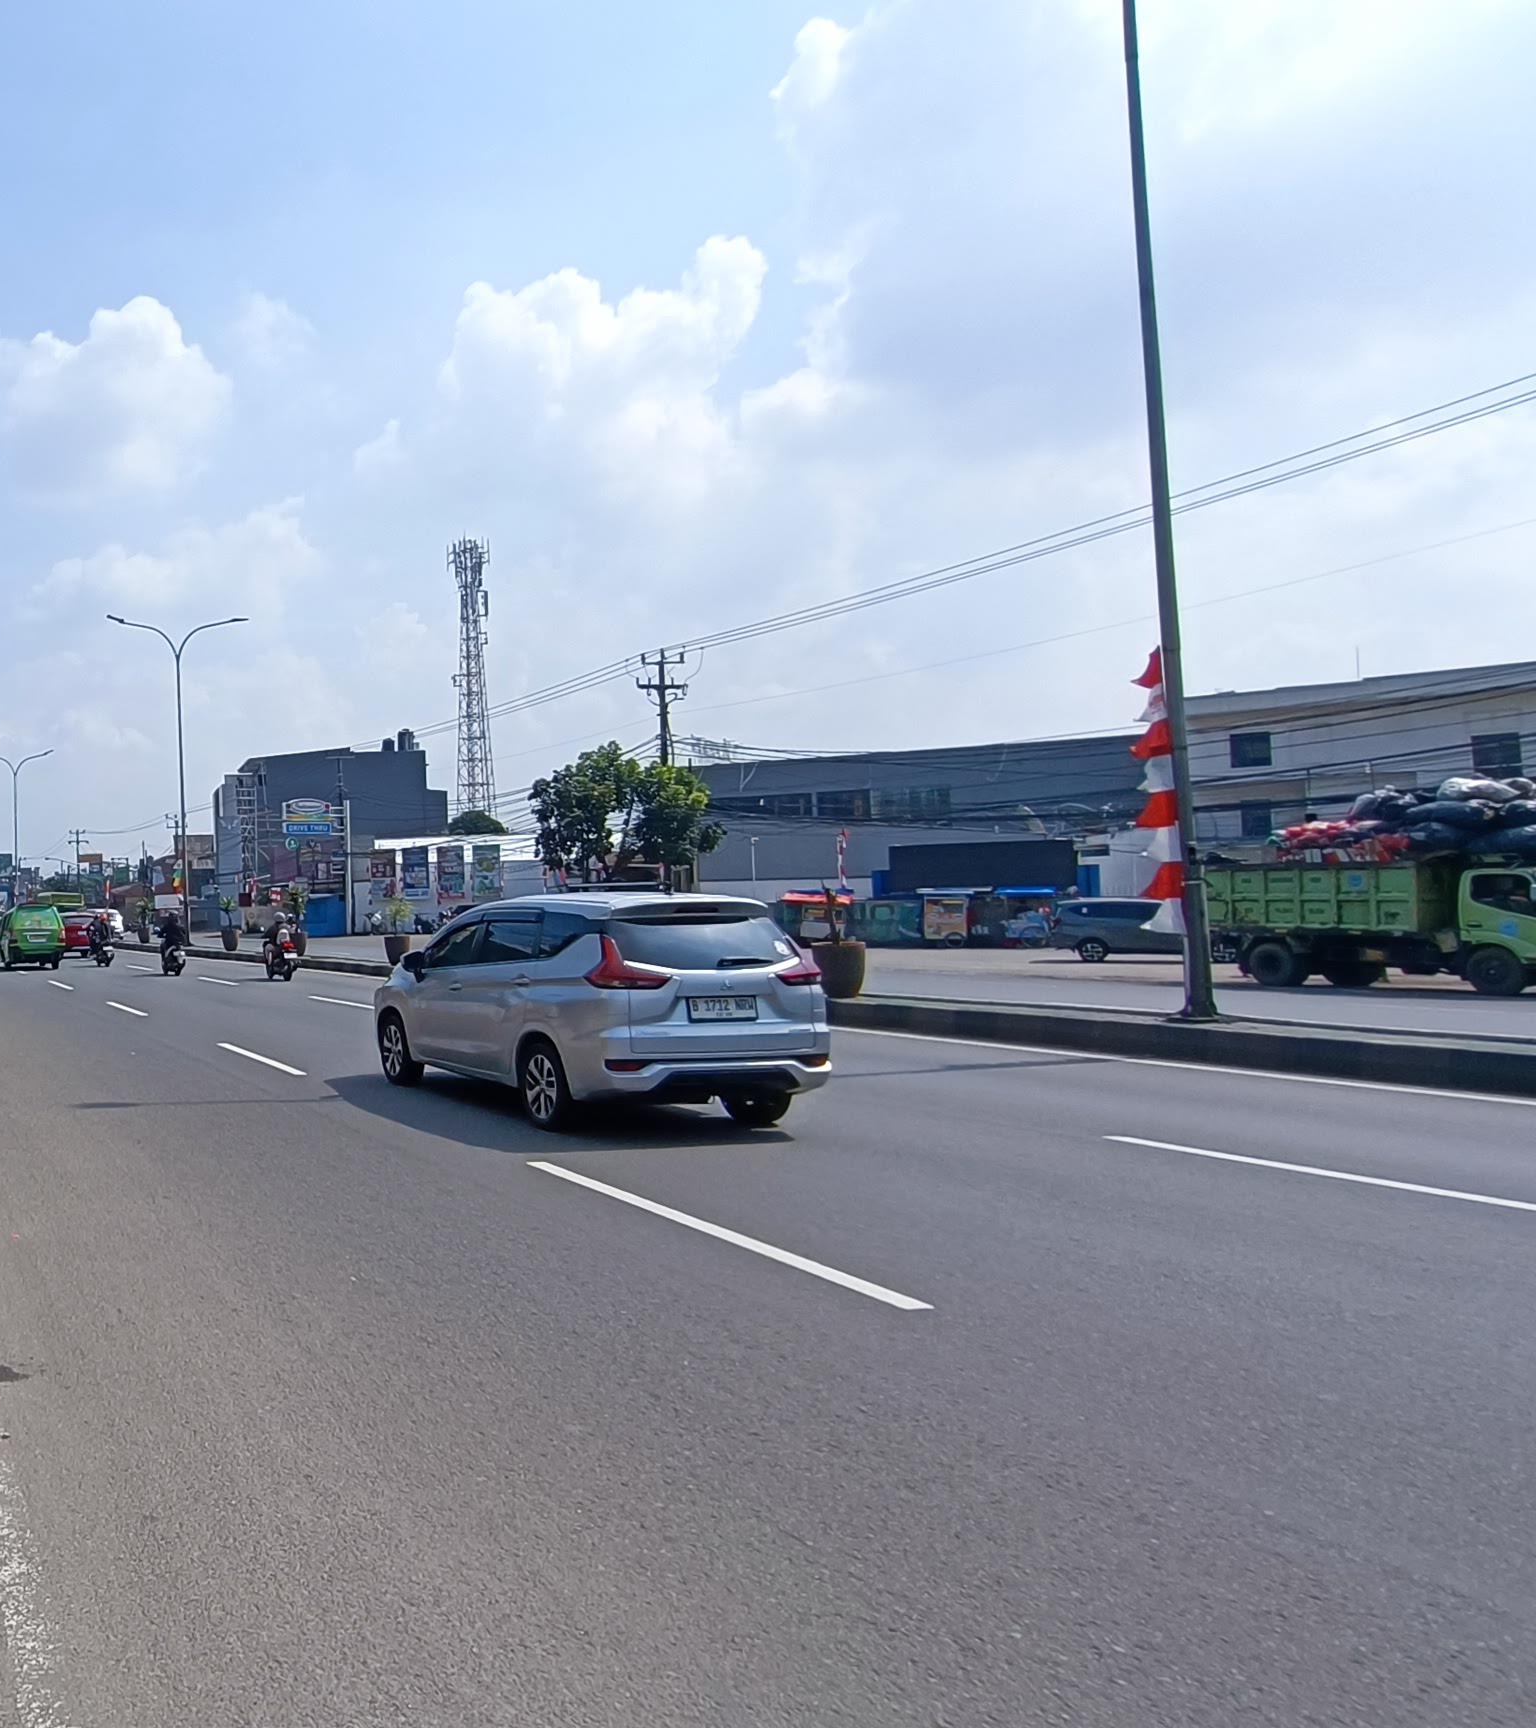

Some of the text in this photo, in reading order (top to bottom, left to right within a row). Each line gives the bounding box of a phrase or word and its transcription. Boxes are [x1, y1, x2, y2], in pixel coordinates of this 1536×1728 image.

[288, 824, 308, 832] DRIVE
[692, 999, 699, 1012] B
[703, 998, 731, 1012] 1712
